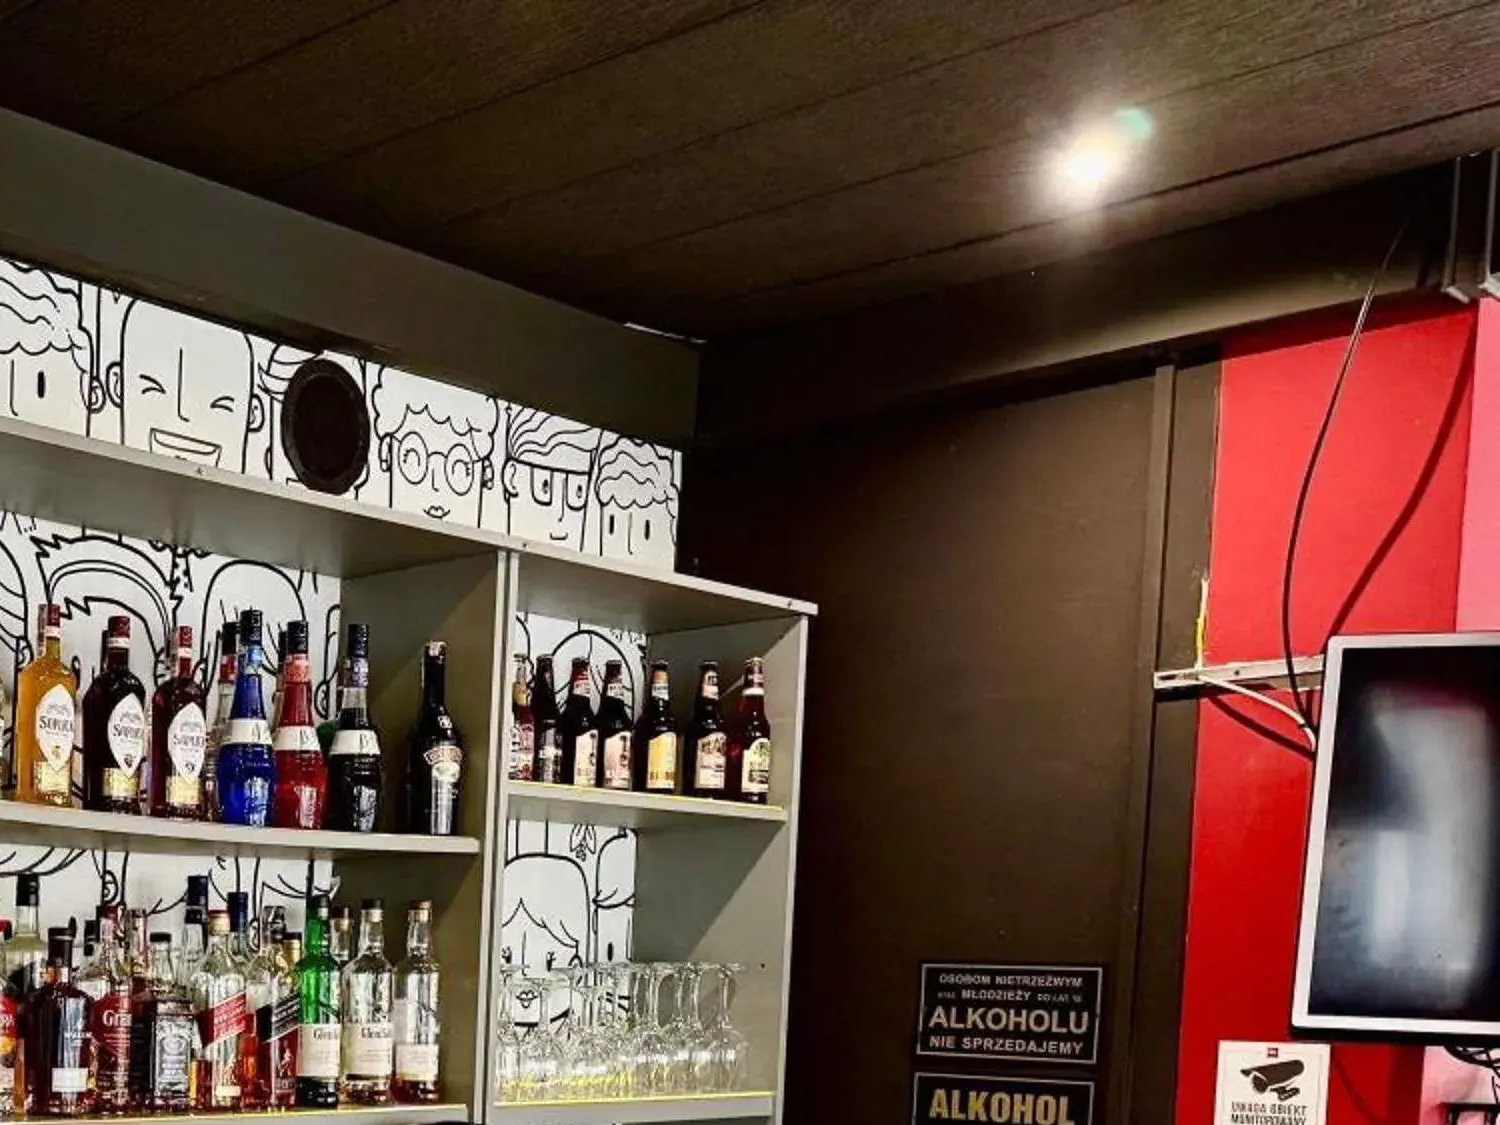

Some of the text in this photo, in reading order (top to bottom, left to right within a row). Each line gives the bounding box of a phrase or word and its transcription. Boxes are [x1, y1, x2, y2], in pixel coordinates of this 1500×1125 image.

[928, 1005, 1090, 1035] ALKOHOLU
[929, 1035, 1084, 1055] NIE SPRZEDAJEMY
